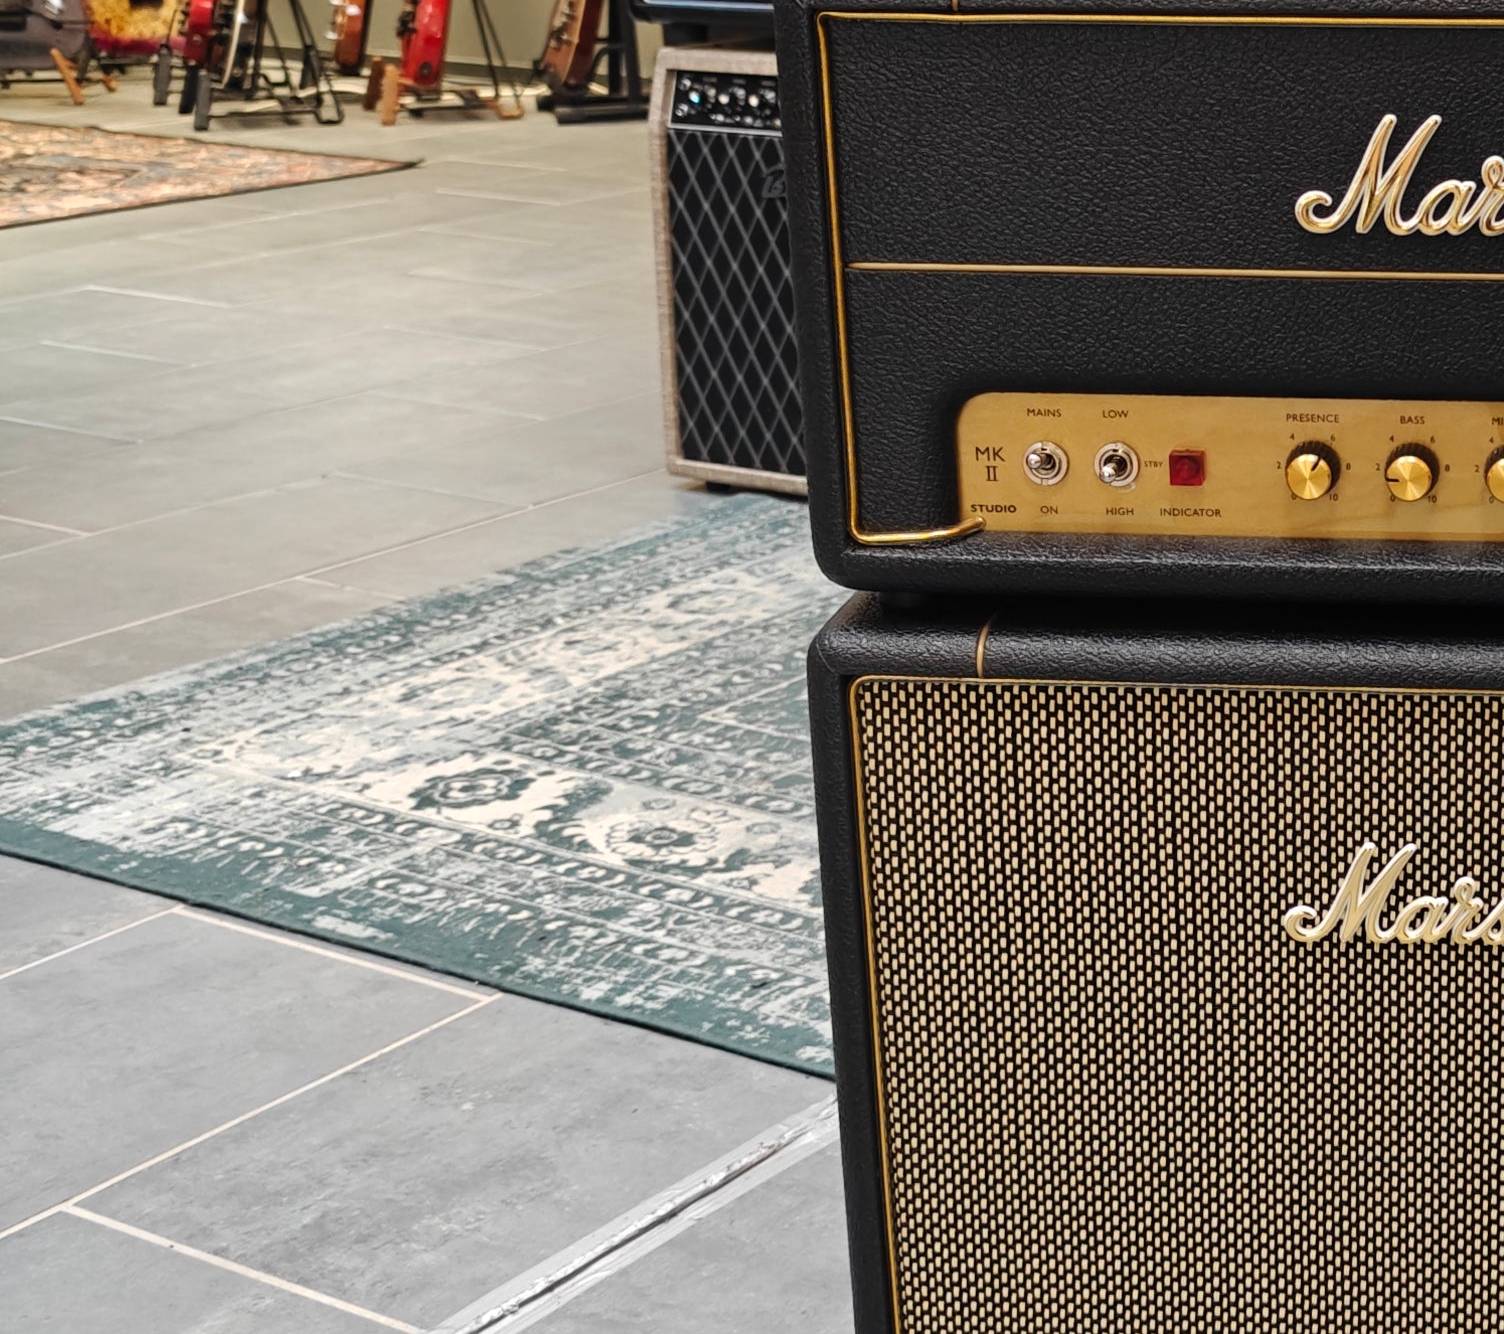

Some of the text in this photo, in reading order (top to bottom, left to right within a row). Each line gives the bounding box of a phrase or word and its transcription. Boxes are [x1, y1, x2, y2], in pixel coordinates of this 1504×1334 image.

[1026, 408, 1062, 418] MAINS
[1102, 409, 1129, 419] LOW
[1286, 413, 1340, 424] PRESENCE
[1400, 415, 1426, 425] BASS
[1330, 434, 1336, 442] 6
[1389, 435, 1395, 443] 4
[975, 446, 1006, 463] MK
[1144, 460, 1164, 468] STBY
[1276, 461, 1282, 469] 2
[1375, 463, 1381, 471] 2
[985, 465, 999, 482] II
[1475, 465, 1480, 473] 2
[1328, 493, 1338, 501] 10
[1427, 495, 1437, 503] 10
[970, 504, 1017, 514] STUDIO
[1039, 505, 1059, 515] ON
[1105, 507, 1134, 516] HIGH
[1159, 507, 1222, 518] INDICATOR
